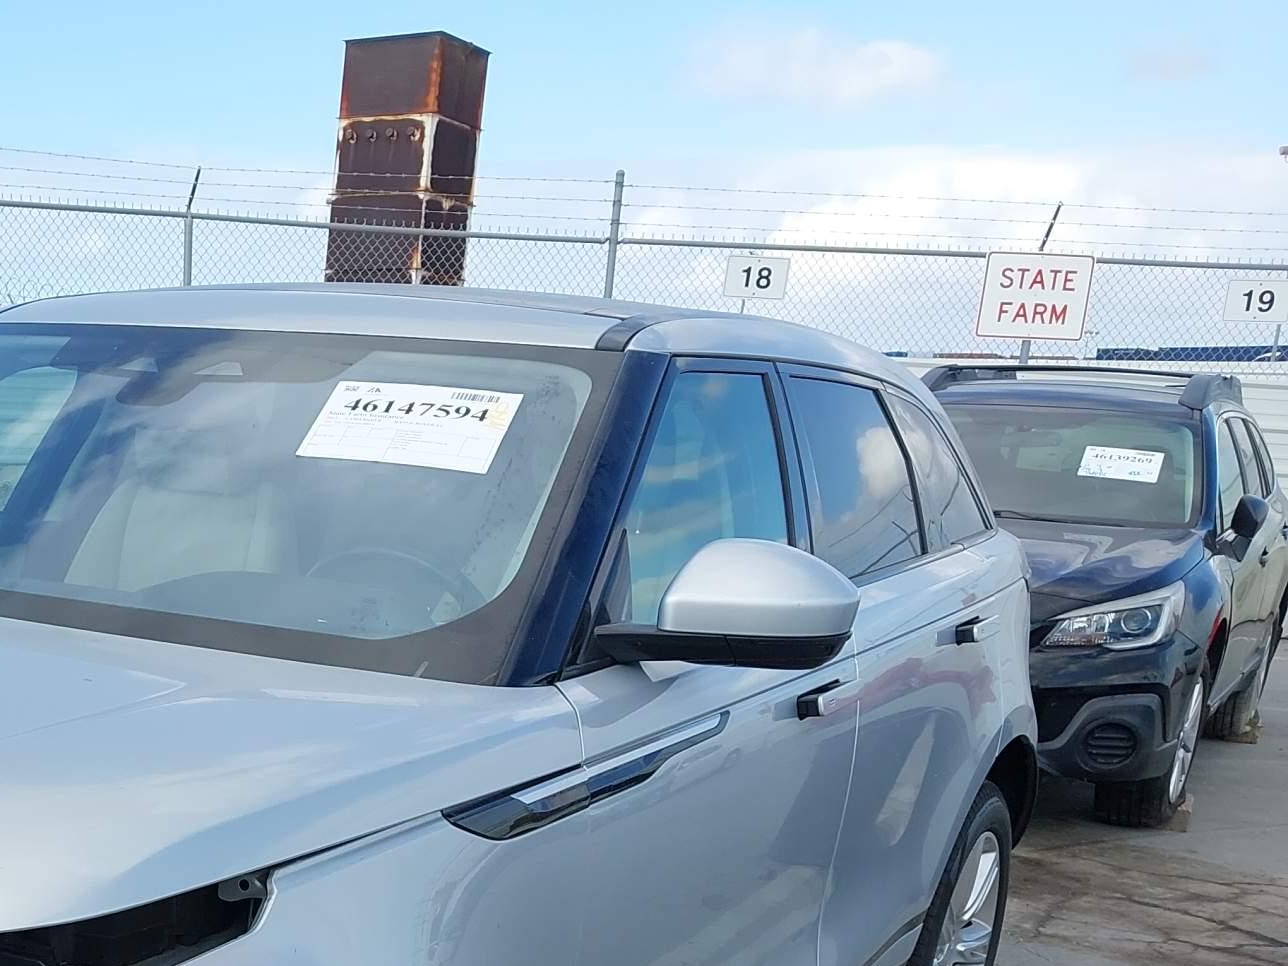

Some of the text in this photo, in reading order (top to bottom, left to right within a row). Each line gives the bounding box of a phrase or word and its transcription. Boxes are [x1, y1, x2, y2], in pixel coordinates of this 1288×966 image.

[741, 266, 772, 290] 18
[999, 267, 1078, 292] STATE
[997, 301, 1068, 326] FARM
[1242, 289, 1275, 313] 19
[343, 397, 489, 422] 46147594
